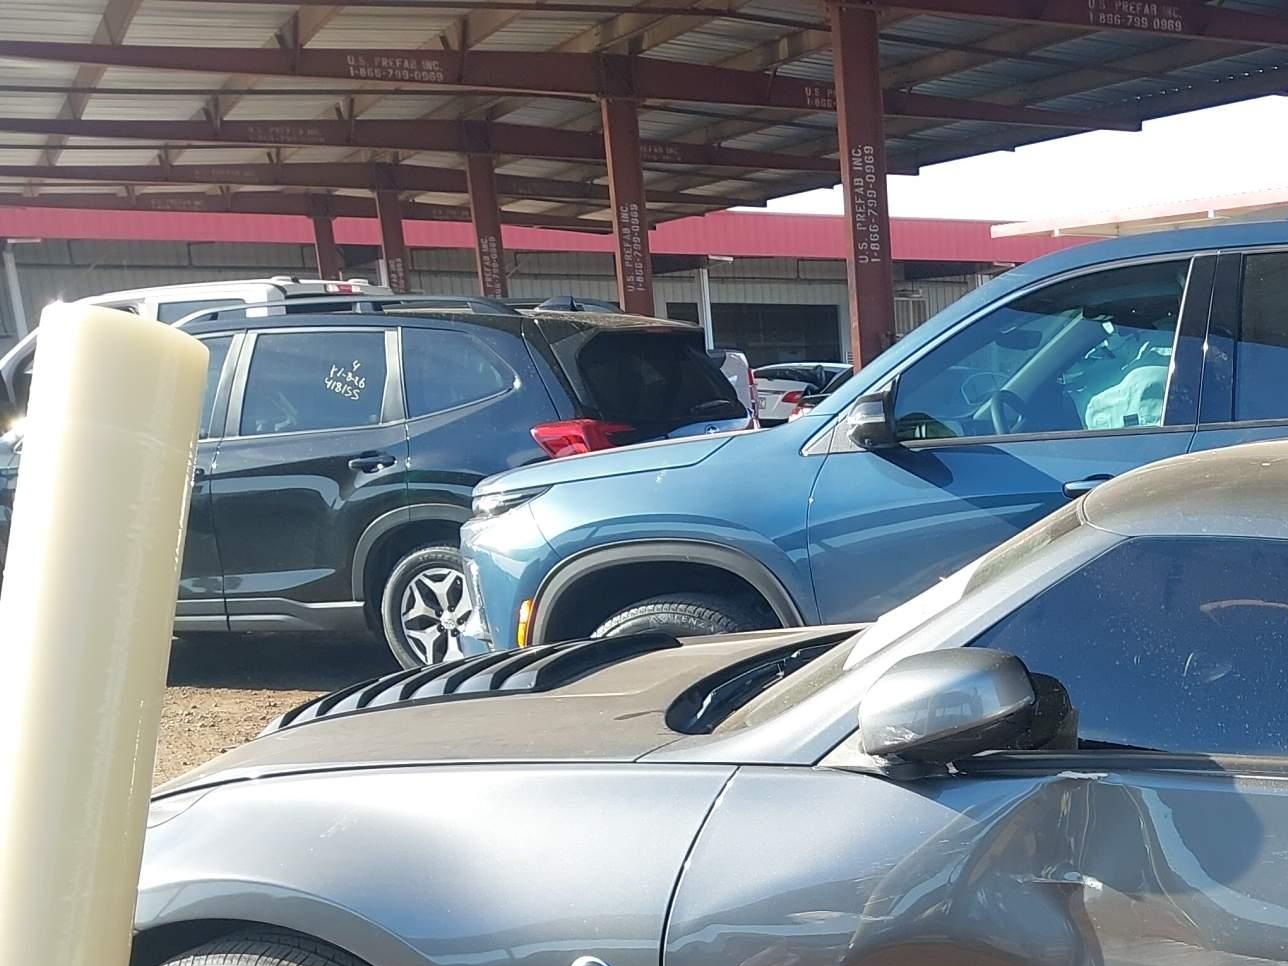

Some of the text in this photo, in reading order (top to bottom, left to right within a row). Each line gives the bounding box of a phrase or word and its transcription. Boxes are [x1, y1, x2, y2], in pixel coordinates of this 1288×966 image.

[1114, 0, 1157, 16] PREFAB
[851, 144, 869, 263] U.S. PREFAB INC.
[863, 145, 881, 262] 1-866-799-0969
[622, 227, 634, 268] PREFAB
[324, 377, 360, 400] 418155
